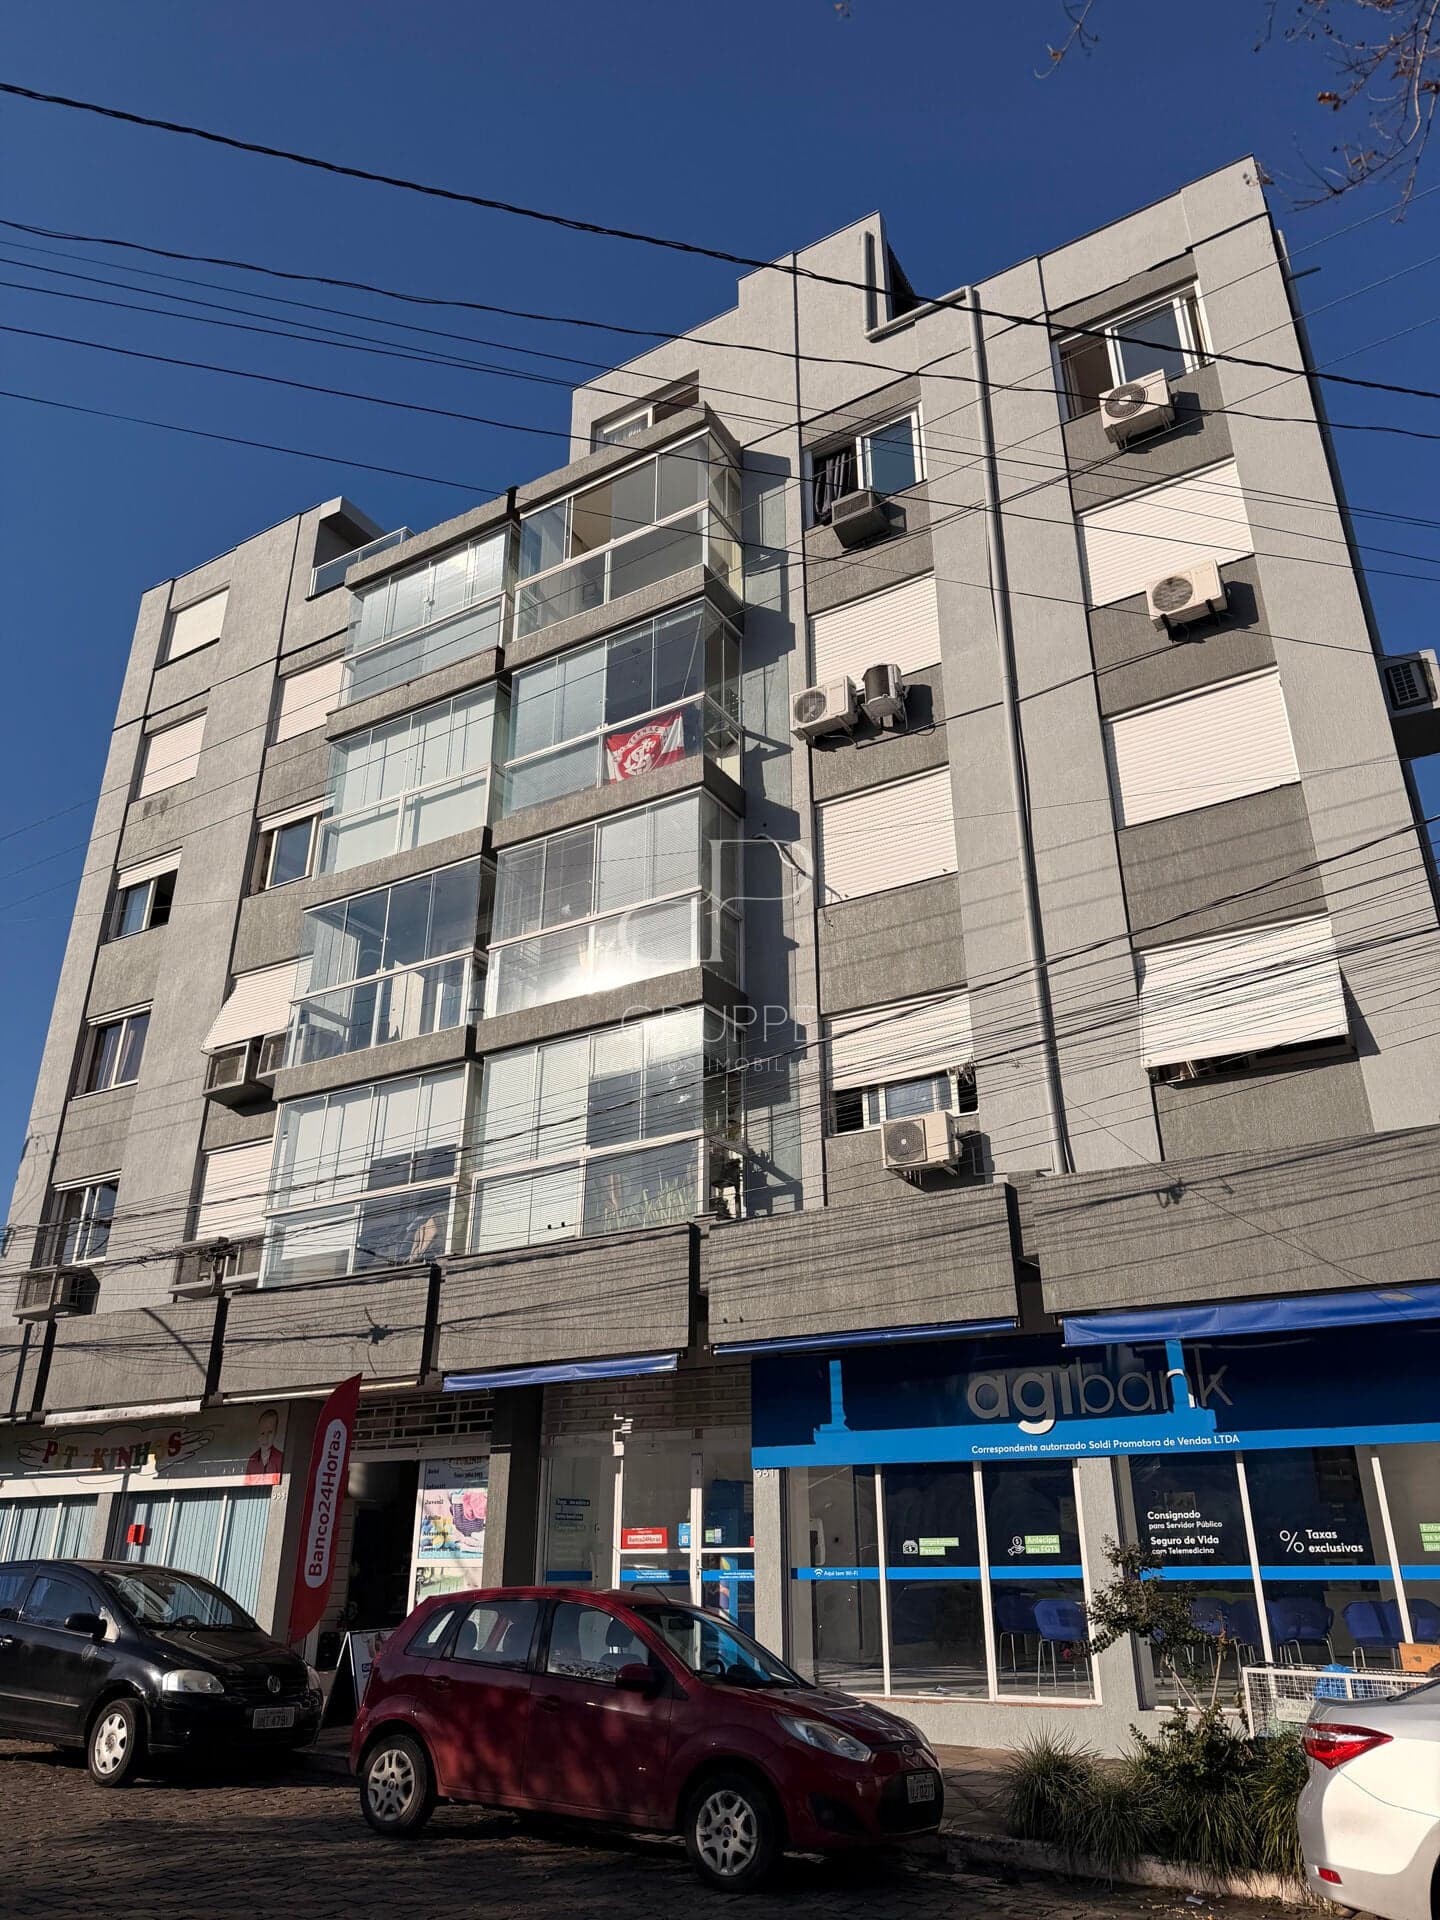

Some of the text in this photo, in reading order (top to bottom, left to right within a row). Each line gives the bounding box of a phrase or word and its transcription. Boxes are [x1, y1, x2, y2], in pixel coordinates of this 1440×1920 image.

[967, 1347, 1234, 1435] agibank
[971, 1434, 1240, 1455] Correspondente autorizado Soldi Promotora de Vendas LTDA
[308, 1429, 342, 1577] Banco24Horas
[1147, 1509, 1201, 1521] Consignado
[1166, 1521, 1195, 1529] Servidor
[1196, 1520, 1223, 1528] Público
[1150, 1534, 1220, 1547] Seguro de Vida
[1304, 1529, 1338, 1540] Taxas
[1308, 1543, 1364, 1553] exclusivas
